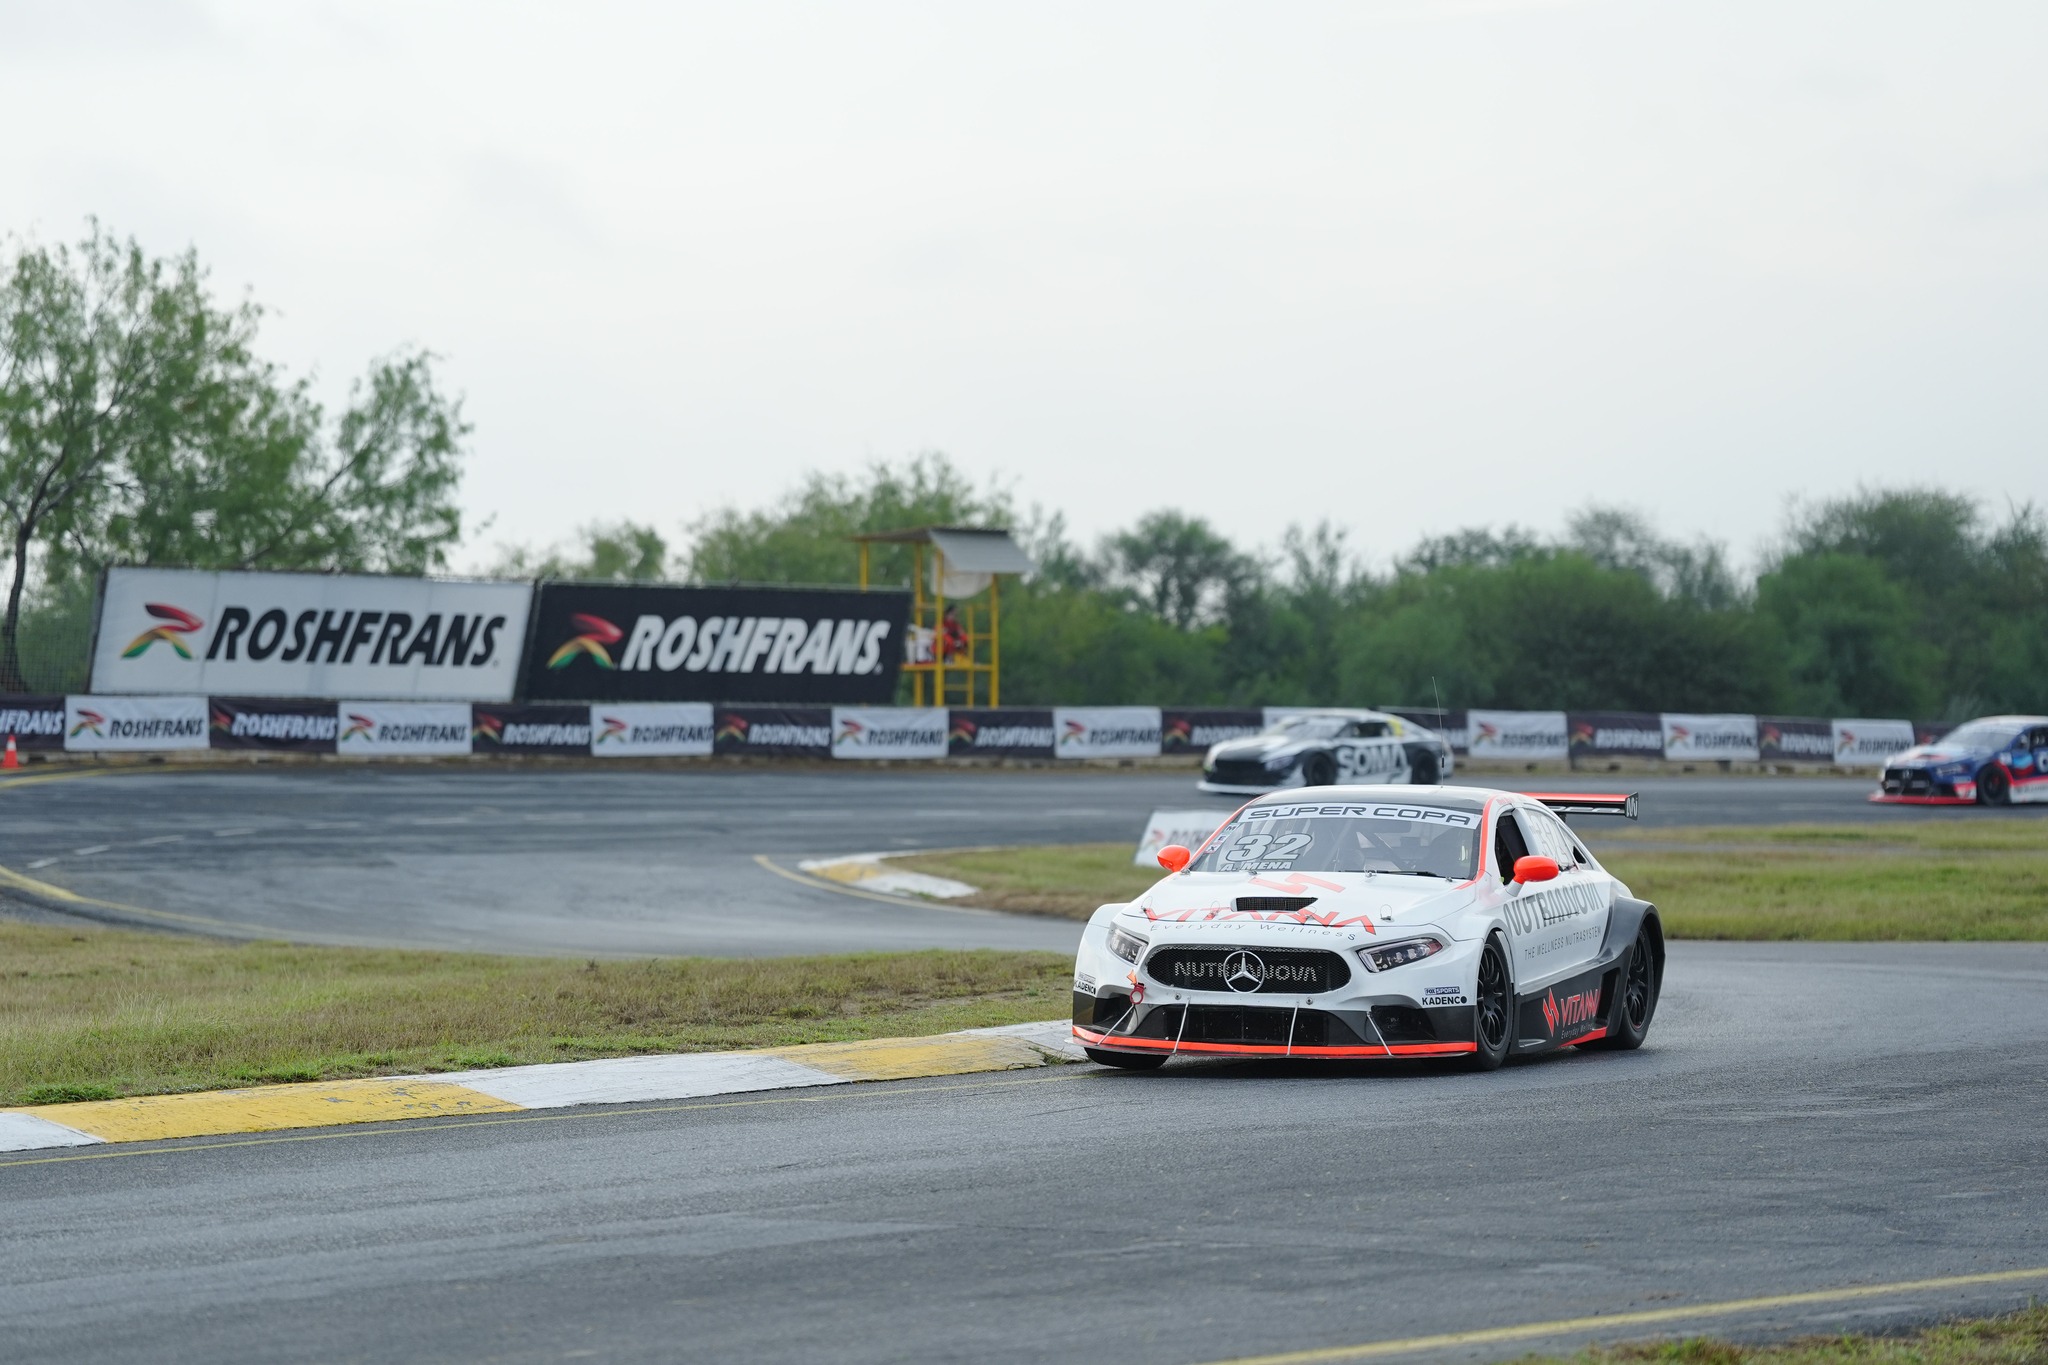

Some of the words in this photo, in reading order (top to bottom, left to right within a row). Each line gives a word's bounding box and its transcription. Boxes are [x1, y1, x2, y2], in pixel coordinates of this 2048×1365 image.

[206, 606, 506, 668] ROSHFRANS
[620, 615, 891, 675] ROSHFRANS
[0, 709, 65, 735] FRANS
[109, 718, 204, 739] ROSHFRANS
[232, 712, 338, 740] ROSHFRANS
[378, 724, 468, 744] ROSHFRANS
[502, 722, 592, 746] ROSHFRANS
[749, 723, 832, 747] ROSHFRANS
[868, 727, 943, 747] ROSHFRANS
[975, 726, 1054, 747] ROSHFRANS
[1336, 744, 1408, 776] SOMA
[1373, 806, 1470, 826] COPA
[1226, 833, 1313, 862] 32
[1240, 861, 1292, 872] MENA
[1150, 922, 1247, 933] Everyday
[1259, 923, 1356, 941] Wellness
[1524, 945, 1535, 961] THE
[1537, 938, 1564, 956] WELLNESS
